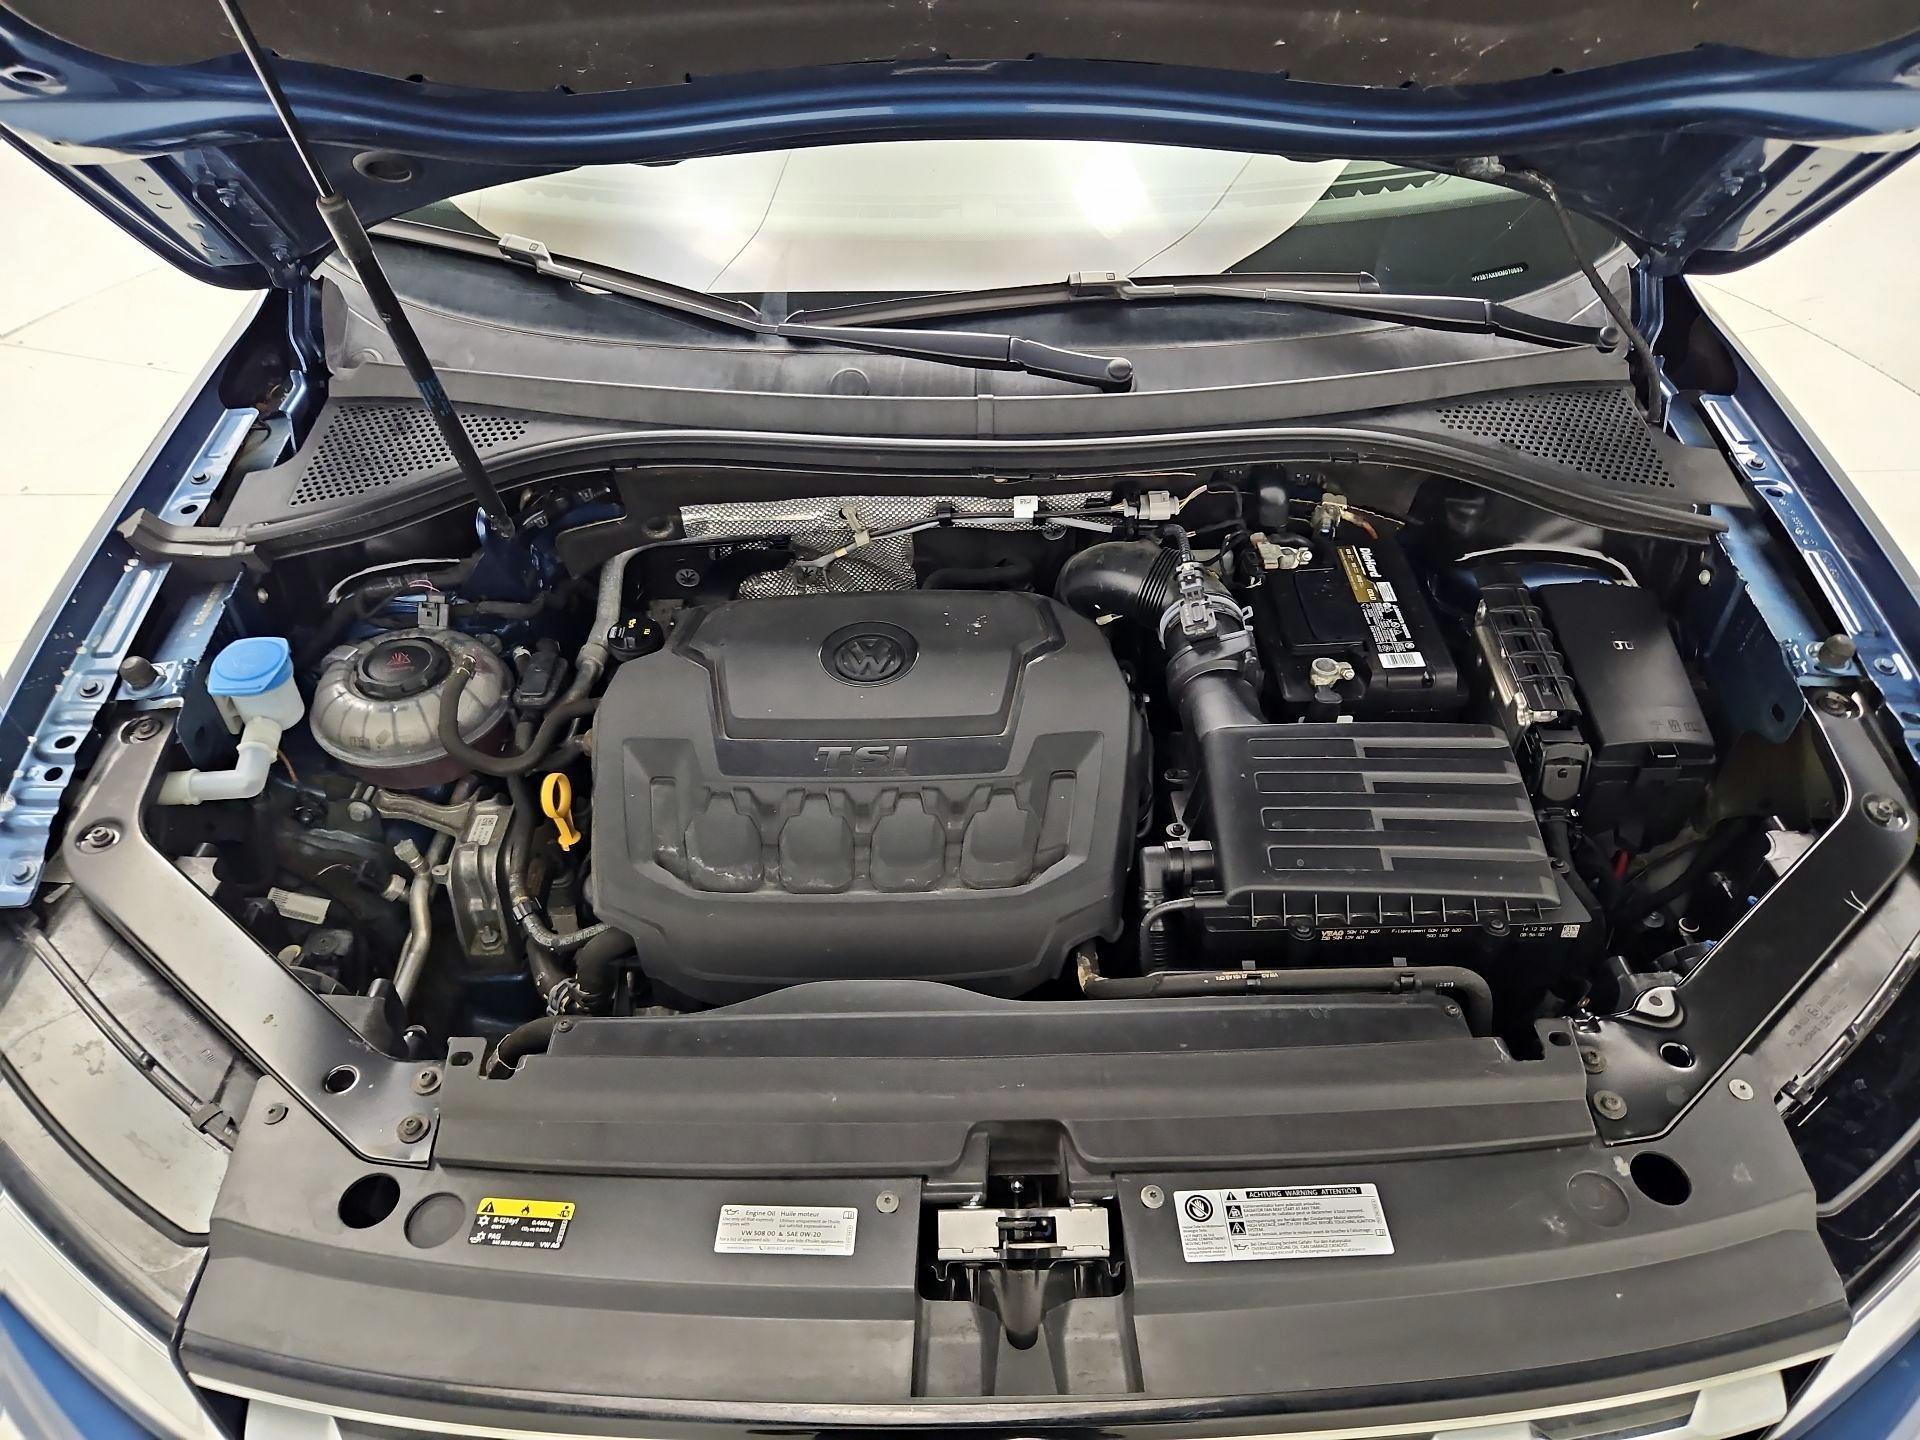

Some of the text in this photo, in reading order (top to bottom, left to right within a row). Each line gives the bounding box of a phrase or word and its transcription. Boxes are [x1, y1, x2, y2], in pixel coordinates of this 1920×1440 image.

[816, 745, 908, 772] TSI
[1249, 1187, 1358, 1198] ACHTUNG WARNING ATTENTION
[745, 1210, 766, 1218] Engine
